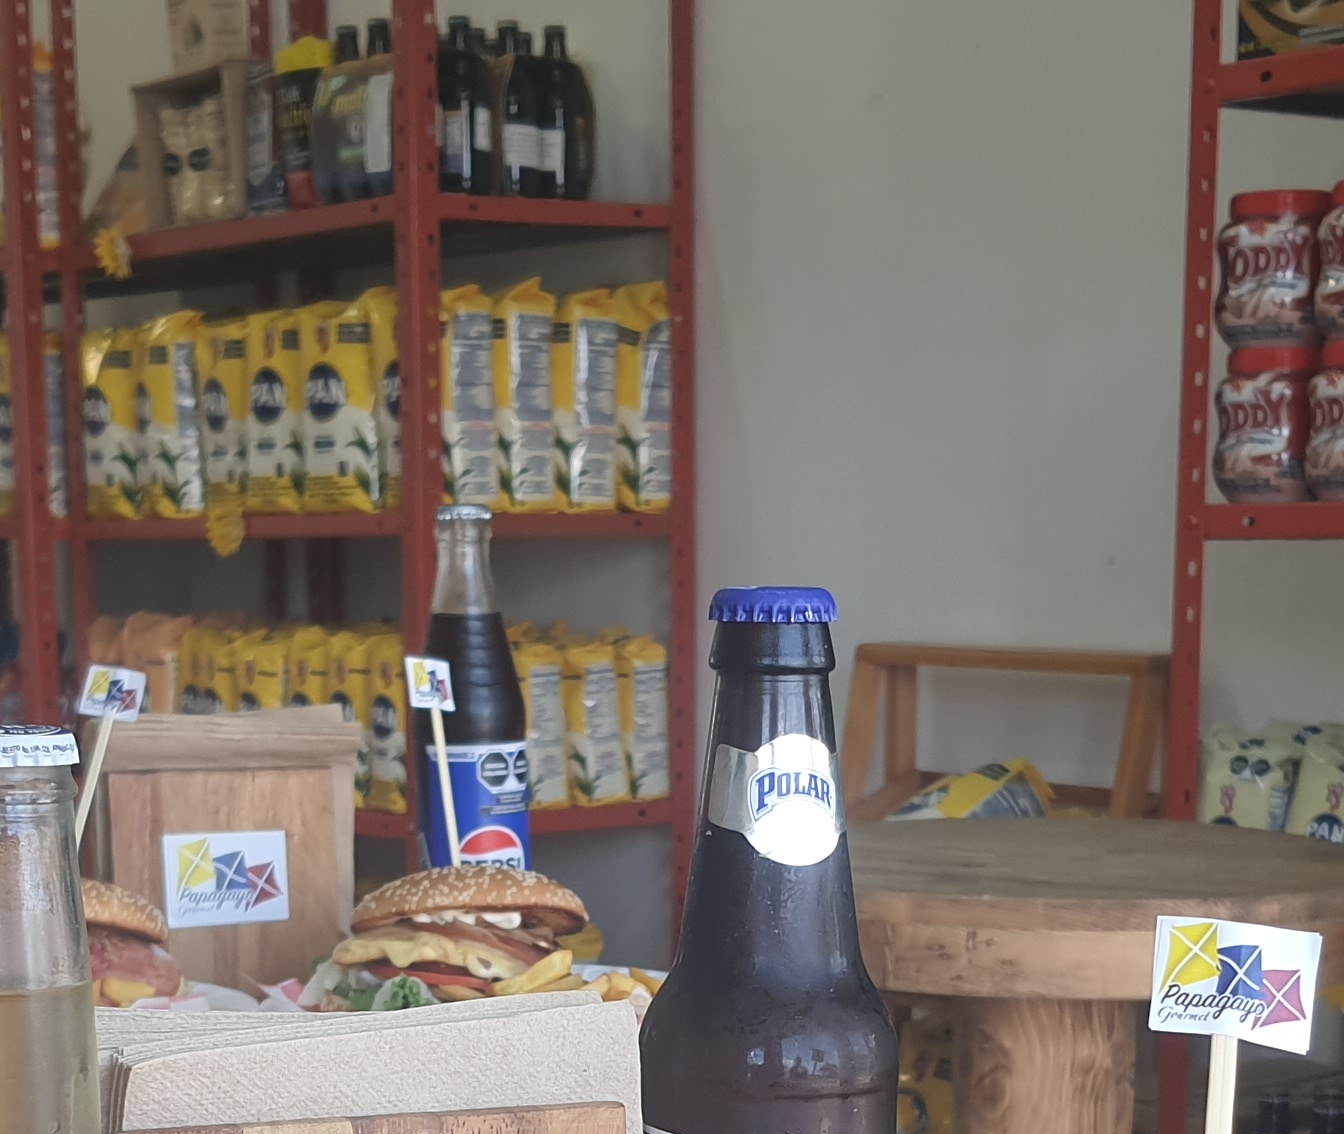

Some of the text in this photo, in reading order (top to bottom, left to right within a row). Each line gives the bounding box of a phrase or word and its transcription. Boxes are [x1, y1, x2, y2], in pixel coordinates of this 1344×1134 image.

[755, 770, 833, 813] POLAR
[179, 887, 255, 912] Papagayo
[1160, 983, 1265, 1024] Papagayo
